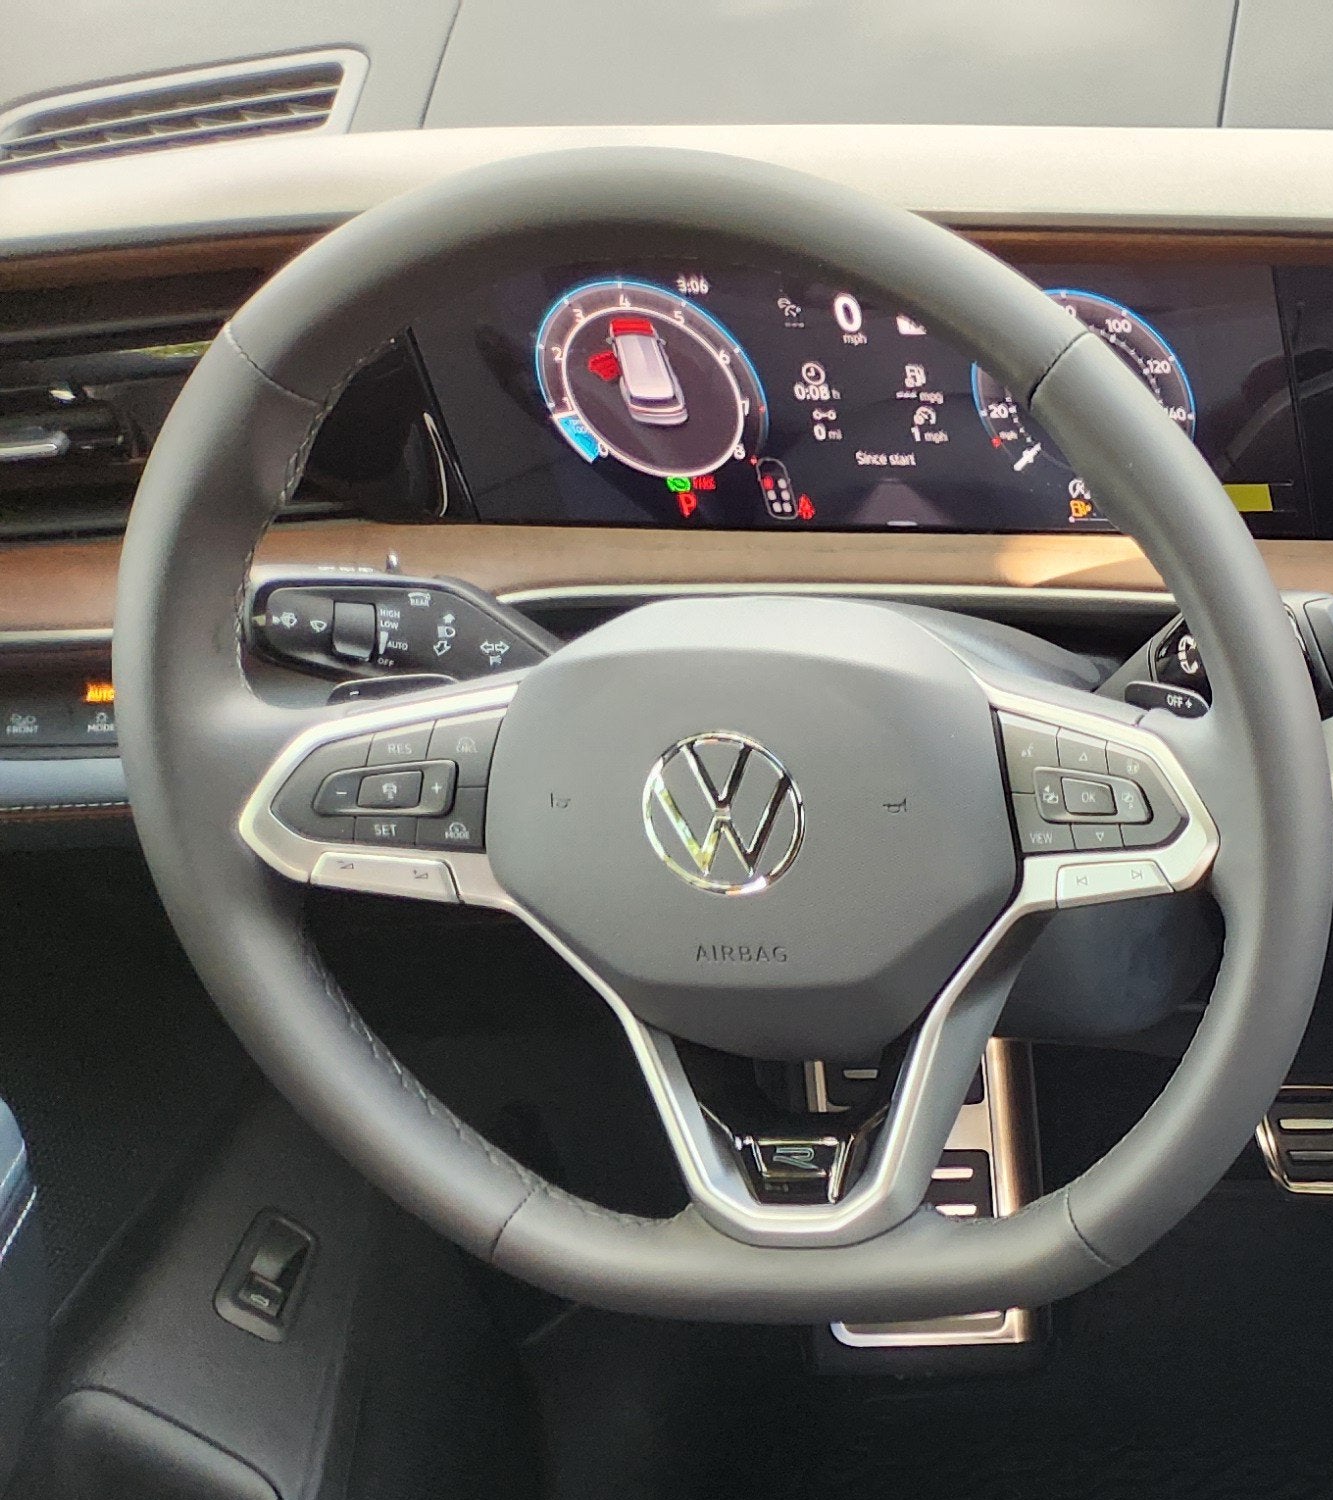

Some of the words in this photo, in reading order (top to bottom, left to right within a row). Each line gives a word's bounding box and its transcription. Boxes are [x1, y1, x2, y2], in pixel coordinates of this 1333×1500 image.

[677, 276, 709, 295] 3:06
[619, 295, 630, 308] 4
[674, 310, 686, 325] 5
[833, 292, 863, 333] 0
[1105, 318, 1133, 334] 100
[842, 333, 868, 346] mph
[551, 348, 563, 362] 2
[719, 352, 731, 366] 6
[1147, 359, 1171, 375] 120
[793, 382, 830, 401] 0:08
[988, 403, 1009, 419] 20
[813, 422, 827, 441] 0
[911, 425, 922, 442] 1
[924, 429, 949, 444] mph
[733, 446, 746, 460] 8
[855, 449, 888, 466] Since
[889, 451, 917, 467] start
[677, 491, 698, 518] P
[379, 608, 400, 619] HIGH
[380, 620, 400, 630] LOW
[387, 641, 408, 651] AUTO
[377, 657, 395, 667] OFF
[1166, 694, 1184, 708] OFF
[387, 743, 413, 755] RES
[1081, 792, 1096, 803] OK
[373, 823, 397, 837] SET
[1029, 832, 1053, 844] VIEW
[695, 944, 788, 963] AIRBAG
